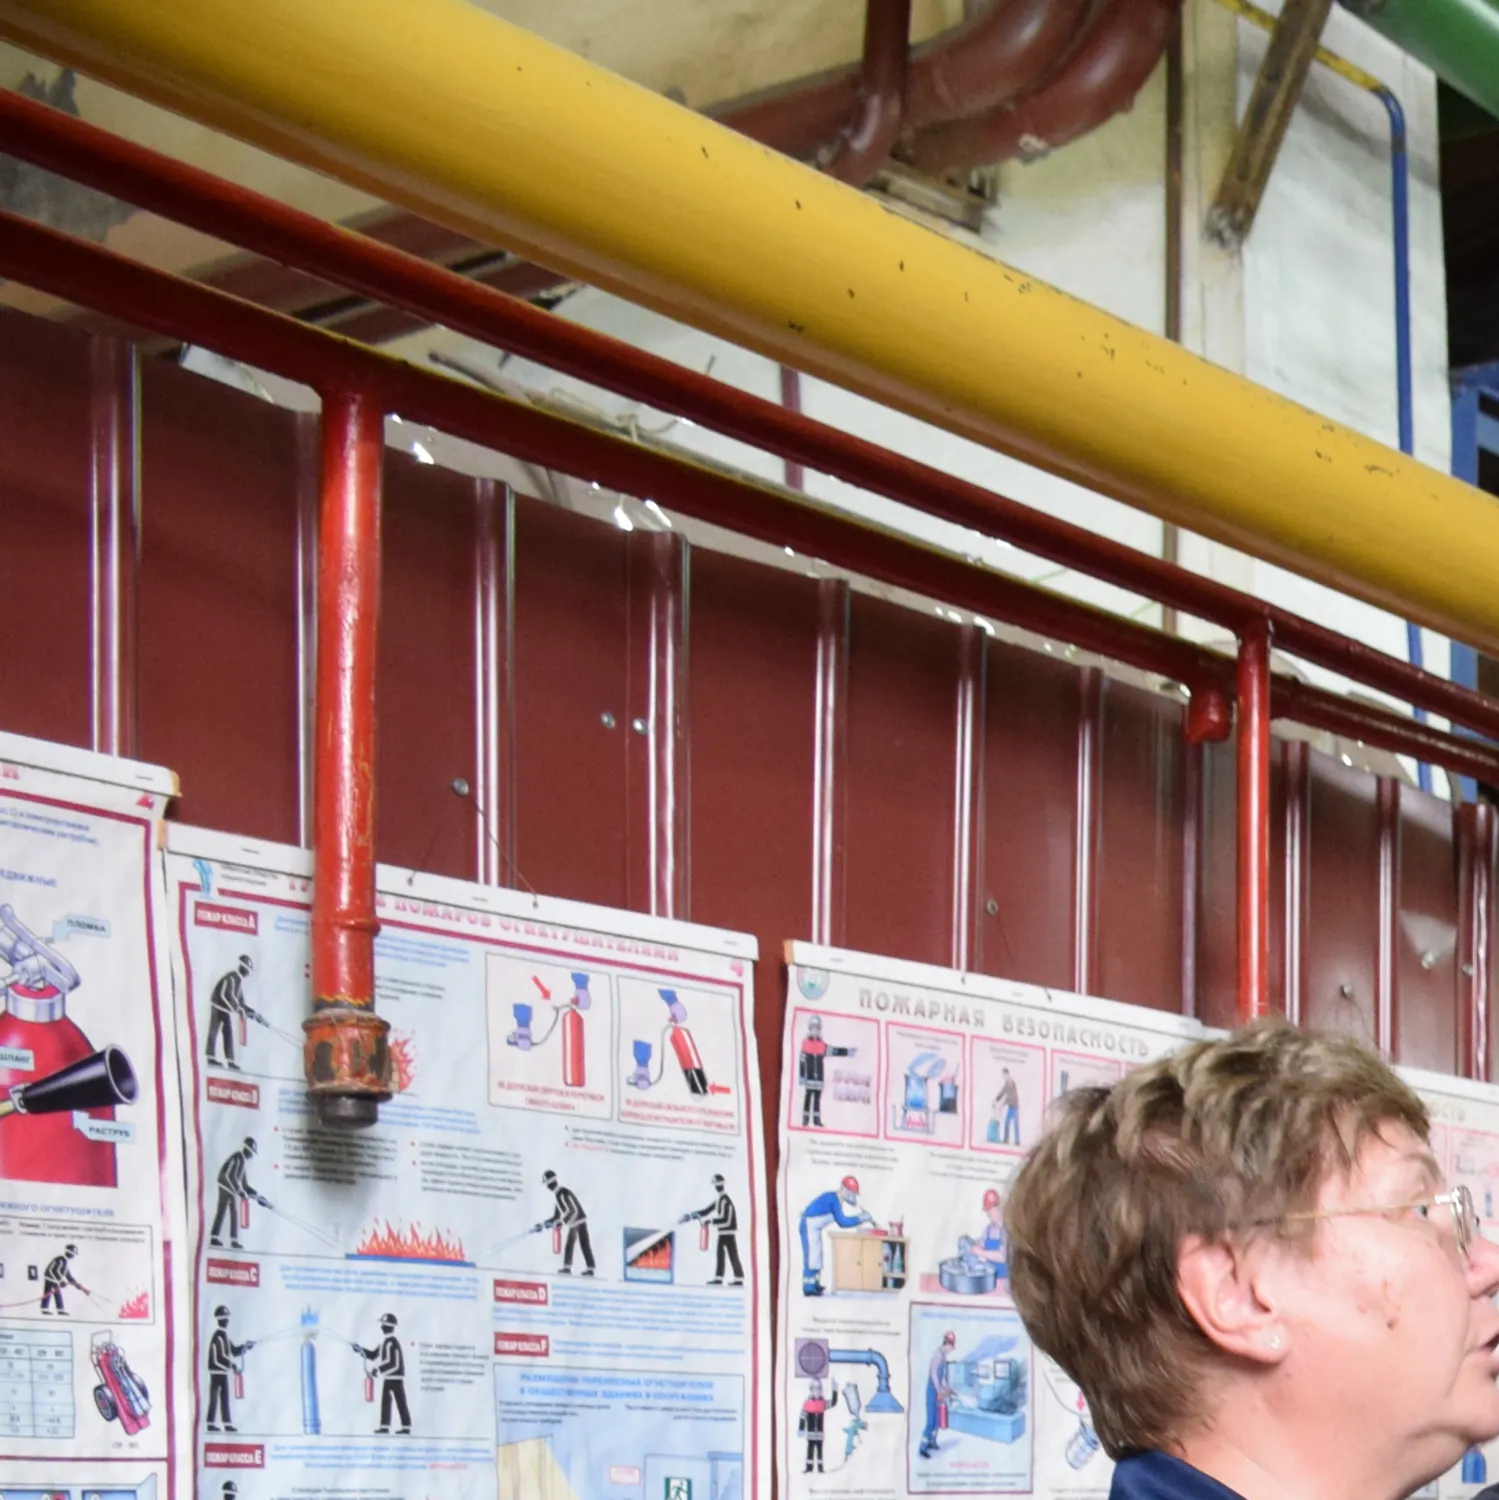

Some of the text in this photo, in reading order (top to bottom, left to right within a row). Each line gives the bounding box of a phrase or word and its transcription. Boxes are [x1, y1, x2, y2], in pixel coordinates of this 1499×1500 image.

[67, 918, 106, 932] ПЛОМБА
[859, 986, 985, 1029] ПОЖАРНАЯ
[1002, 1014, 1150, 1058] БЕЗОПАСНОСТЬ
[88, 1125, 130, 1138] РАСТРУБ
